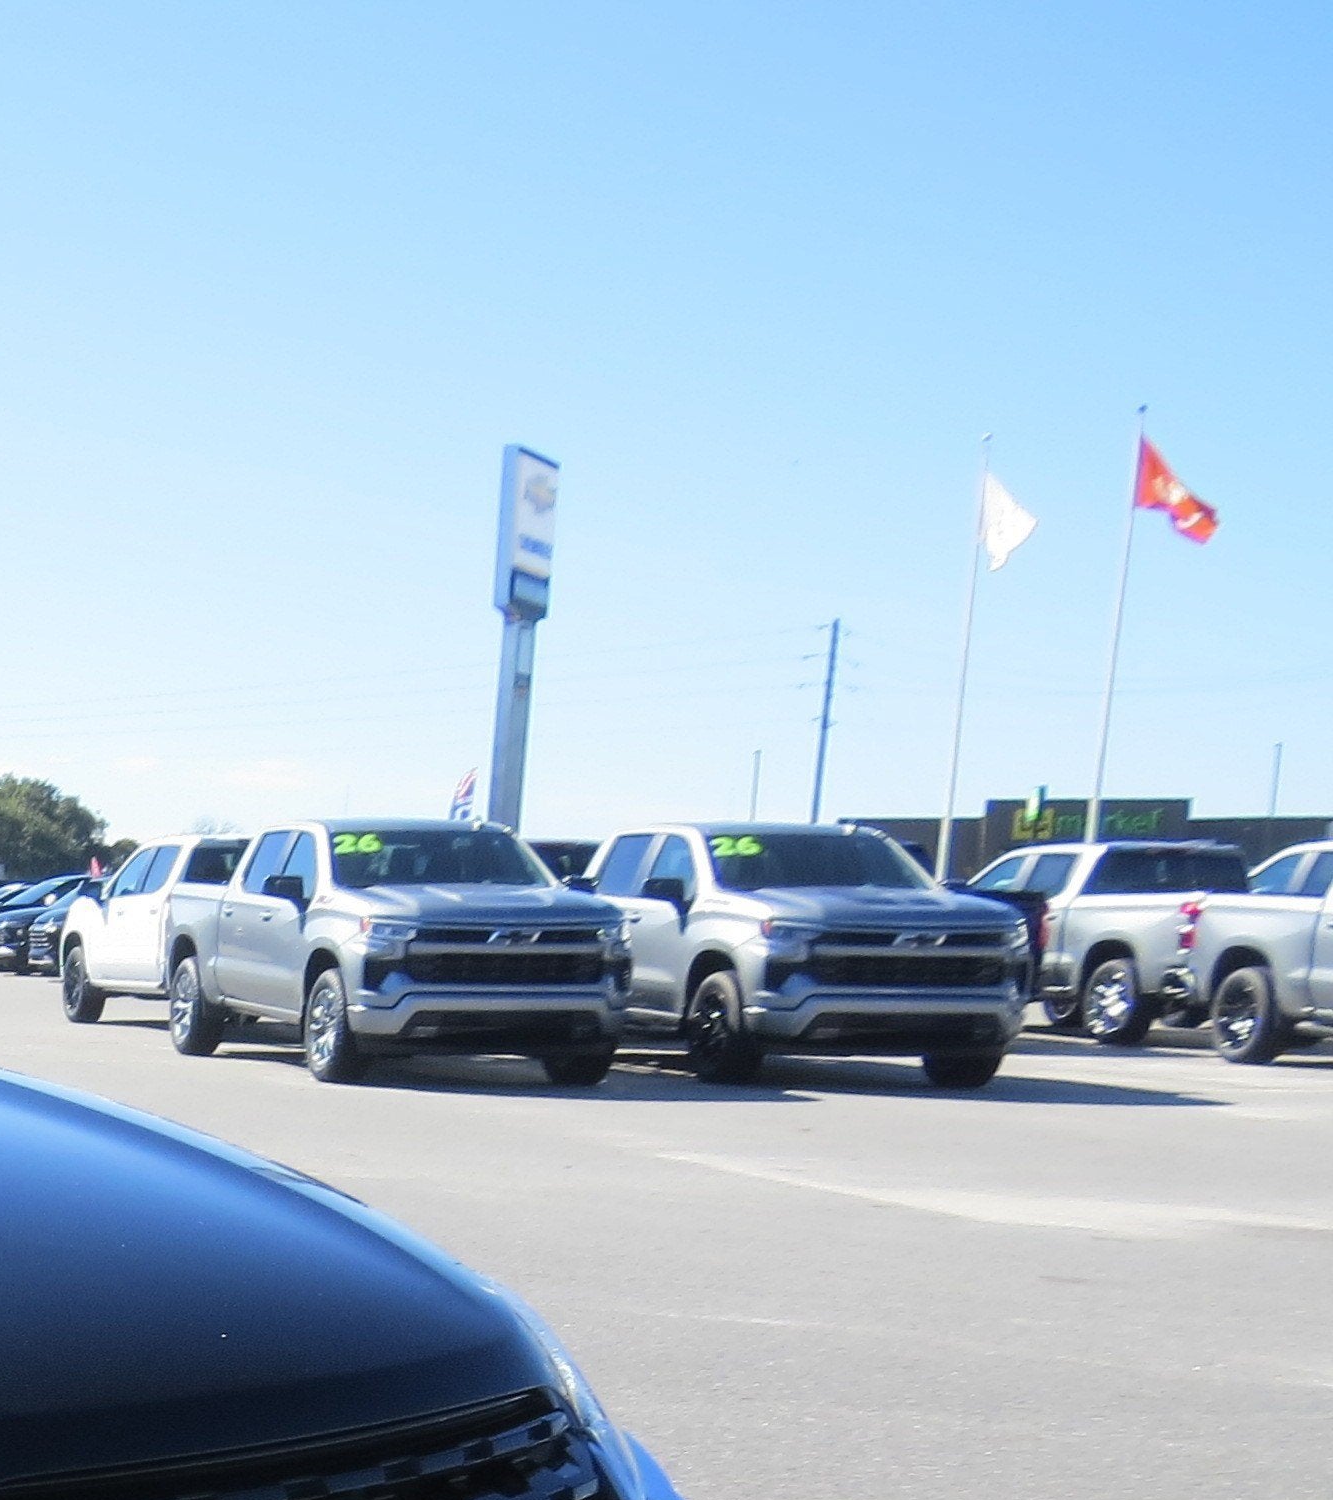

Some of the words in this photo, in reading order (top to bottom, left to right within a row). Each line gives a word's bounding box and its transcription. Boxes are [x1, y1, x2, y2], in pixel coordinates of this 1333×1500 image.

[1055, 809, 1164, 837] mrket
[332, 832, 384, 855] 26
[709, 834, 763, 857] 26
